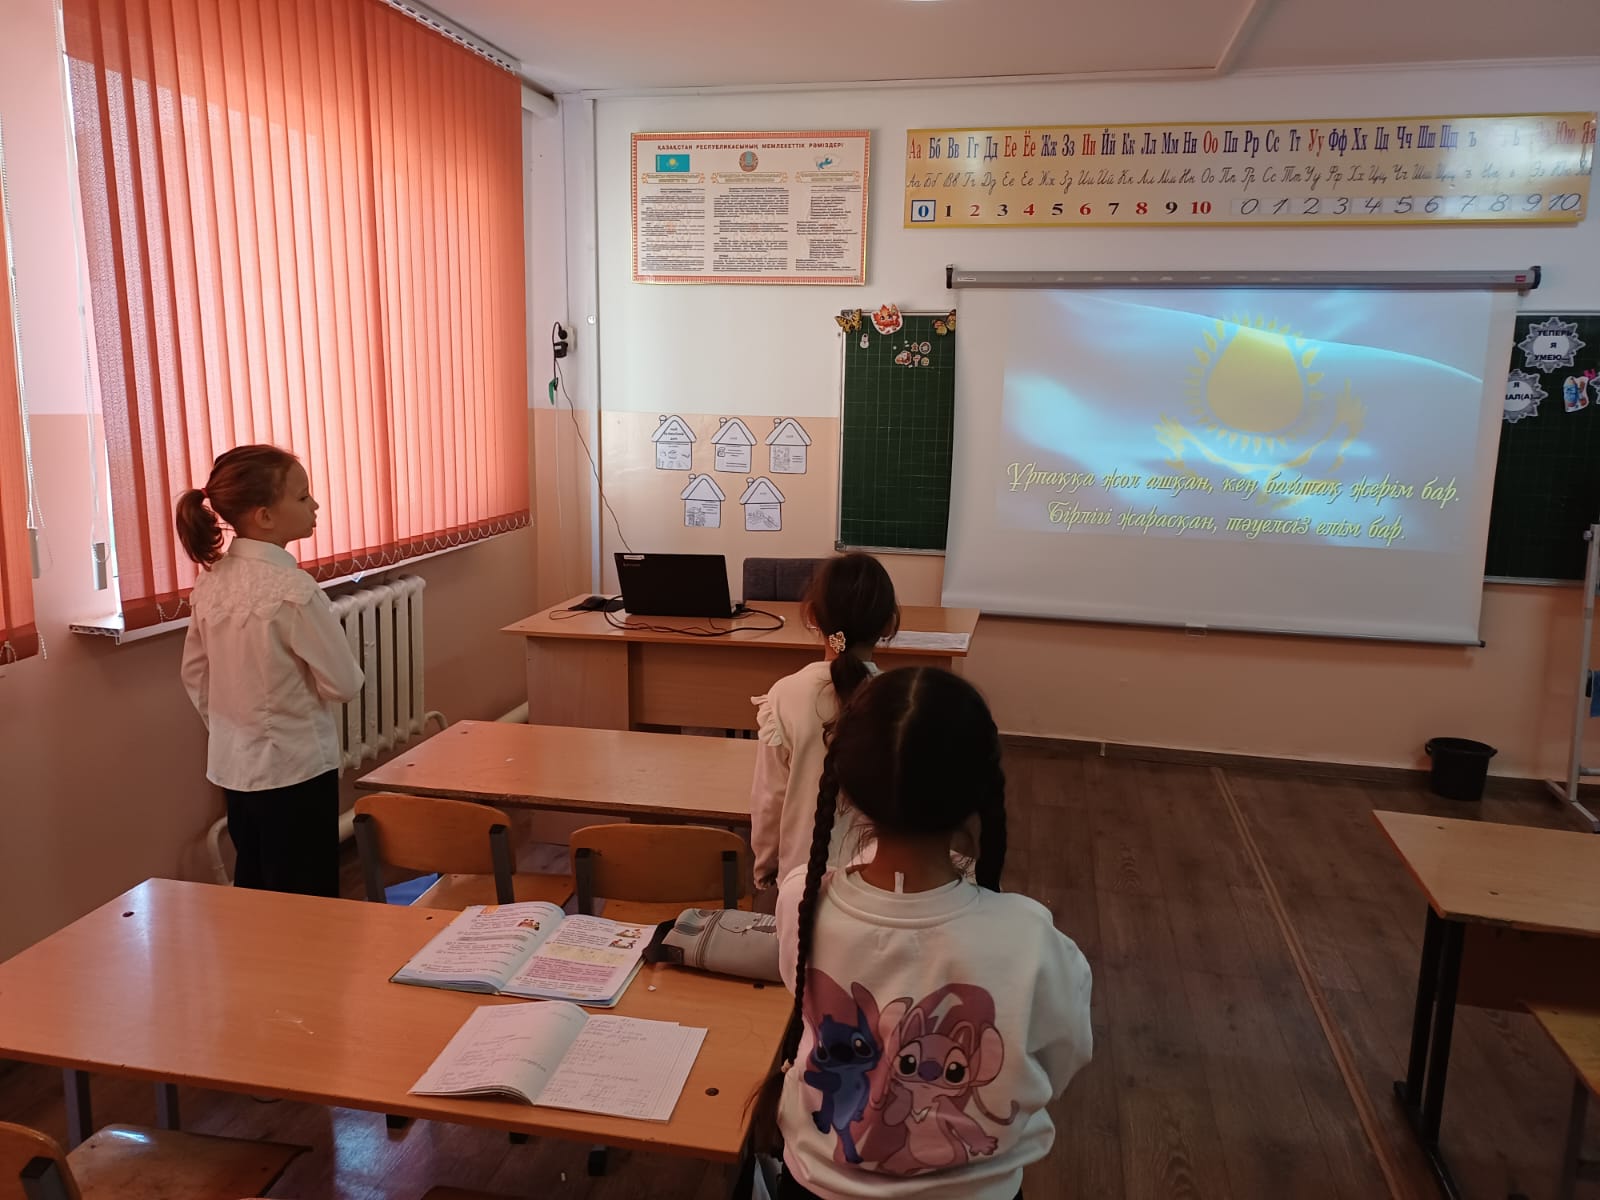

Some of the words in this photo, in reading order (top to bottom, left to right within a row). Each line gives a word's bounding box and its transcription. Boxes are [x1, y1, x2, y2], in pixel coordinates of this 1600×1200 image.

[909, 137, 921, 159] Аа
[929, 138, 941, 159] Бб
[948, 137, 960, 159] Вв
[967, 137, 979, 158] Гг
[984, 136, 998, 161] Дд
[1004, 136, 1017, 158] Ее
[1041, 134, 1057, 156] Жж
[1062, 134, 1075, 156] Зз
[1082, 134, 1096, 156] Ии
[1101, 128, 1116, 155] Йй
[1122, 132, 1135, 154] Кк
[1141, 132, 1157, 154] Лл
[1161, 132, 1179, 154] Мм
[1183, 132, 1198, 154] Нн
[1204, 130, 1218, 154] Оо
[1223, 131, 1238, 152] Пп
[1244, 130, 1259, 158] Рр
[1266, 130, 1279, 152] Сс
[1290, 129, 1301, 151] Тт
[1309, 129, 1324, 157] Уу
[1329, 129, 1347, 156] Фф
[1352, 128, 1368, 150] Хх
[1375, 127, 1389, 151] Цц
[1397, 126, 1412, 149] Чч
[1417, 126, 1436, 148] Шш
[1440, 125, 1459, 150] Щщ
[907, 173, 921, 187] Аа
[924, 173, 943, 188] Бб
[943, 172, 960, 187] Вв
[962, 172, 976, 187] Гг
[981, 172, 996, 196] Дд
[1002, 172, 1015, 187] Ее
[1060, 170, 1072, 194] Зз
[1078, 170, 1094, 186] Ии
[1118, 170, 1133, 184] Кк
[1137, 169, 1155, 184] Лл
[1157, 169, 1176, 184] Мм
[1179, 168, 1195, 184] Нн
[1201, 168, 1214, 183] Оо
[1219, 167, 1236, 183] Пп
[1241, 166, 1256, 192] Рр
[1263, 167, 1277, 182] Сс
[1305, 166, 1321, 191] Уу
[1326, 166, 1343, 190] Фф
[1347, 165, 1365, 181] Хх
[1393, 164, 1408, 180] Чч
[918, 205, 929, 217] 0
[945, 205, 952, 217] 1
[970, 205, 980, 216] 2
[997, 204, 1008, 216] 3
[1024, 203, 1035, 215] 4
[1052, 203, 1063, 215] 5
[1080, 203, 1093, 215] 6
[1108, 203, 1120, 215] 7
[1136, 202, 1148, 214] 8
[1166, 202, 1178, 214] 9
[1192, 201, 1211, 214] 10
[1241, 199, 1258, 214] 0
[1273, 198, 1288, 214] 1
[1303, 197, 1319, 214] 2
[1333, 197, 1348, 214] 3
[1365, 197, 1383, 214] 4
[1394, 196, 1412, 213] 5
[1425, 196, 1443, 213] 6
[1461, 195, 1477, 212] 7
[1489, 194, 1510, 212] 8
[1522, 194, 1542, 211] 9
[1548, 193, 1581, 211] 10
[1101, 468, 1140, 492] жол
[1146, 475, 1214, 497] ашқан,
[1222, 478, 1258, 500] кең
[1350, 473, 1414, 505] жерім
[1421, 476, 1460, 509] бар.
[1117, 504, 1218, 536] жарасқан,
[1226, 516, 1311, 540] тәуелсіз
[1316, 519, 1361, 538] елім
[1368, 514, 1405, 547] бар.
